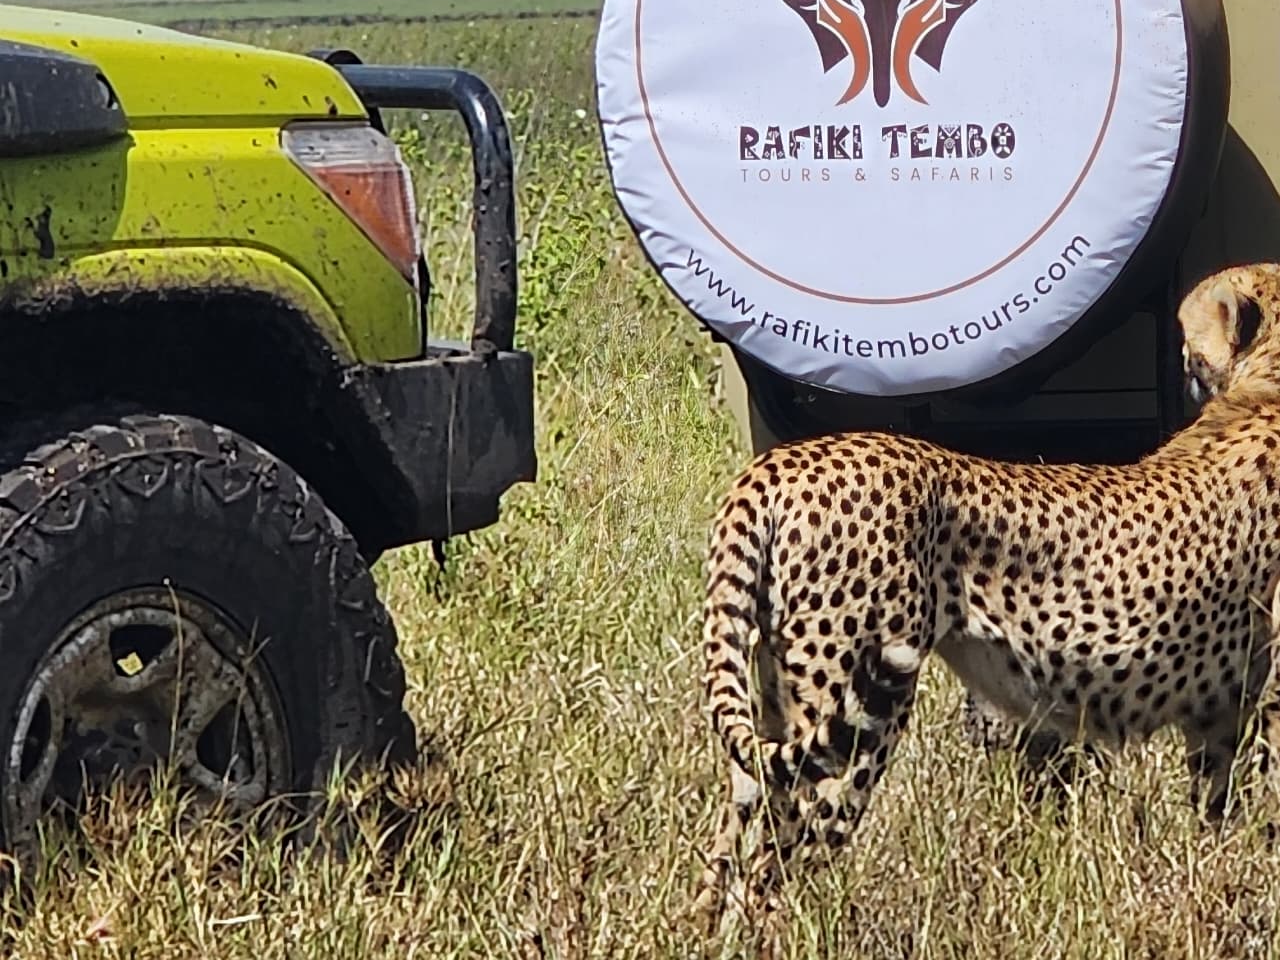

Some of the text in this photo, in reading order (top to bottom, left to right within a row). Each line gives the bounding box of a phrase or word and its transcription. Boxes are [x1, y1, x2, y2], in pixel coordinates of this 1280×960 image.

[739, 122, 1016, 161] RAFIKI TEMBO
[741, 166, 1013, 183] TOURS & SAFARIS
[686, 234, 1091, 359] www.rafikitembotours.com
